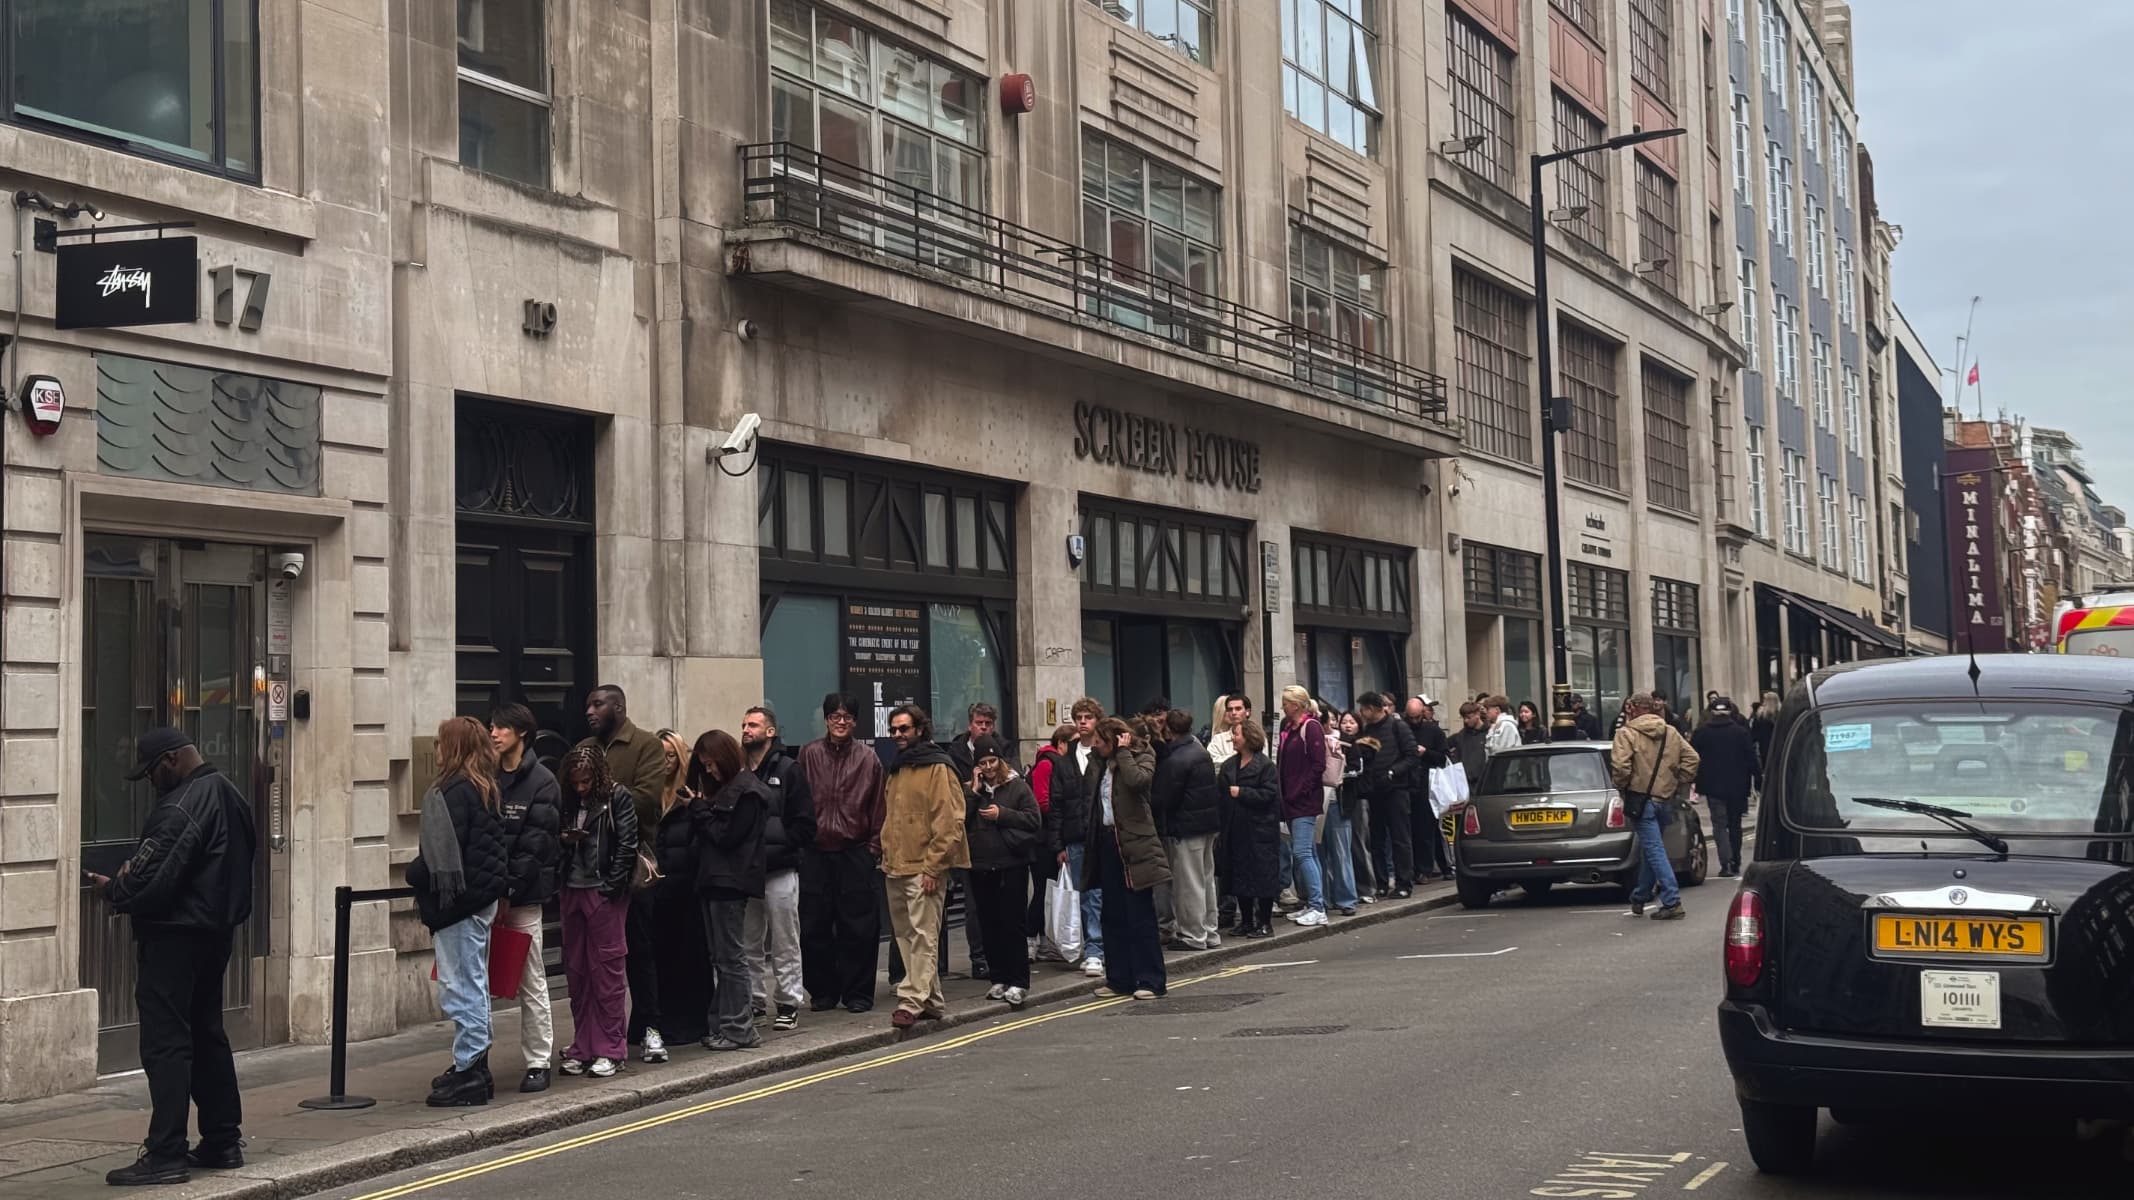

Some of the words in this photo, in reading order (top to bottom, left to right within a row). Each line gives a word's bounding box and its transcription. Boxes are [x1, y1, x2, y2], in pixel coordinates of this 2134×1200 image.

[522, 299, 557, 338] 119
[1074, 400, 1177, 478] SCREEN
[1184, 425, 1261, 494] HOUSE
[1962, 491, 1985, 624] MINALIMA
[1546, 809, 1568, 821] FKP
[1895, 920, 1958, 947] LN14
[1968, 922, 2025, 949] WYS
[1943, 991, 1980, 1006] 101111
[1529, 1152, 1693, 1199] TAXIS
